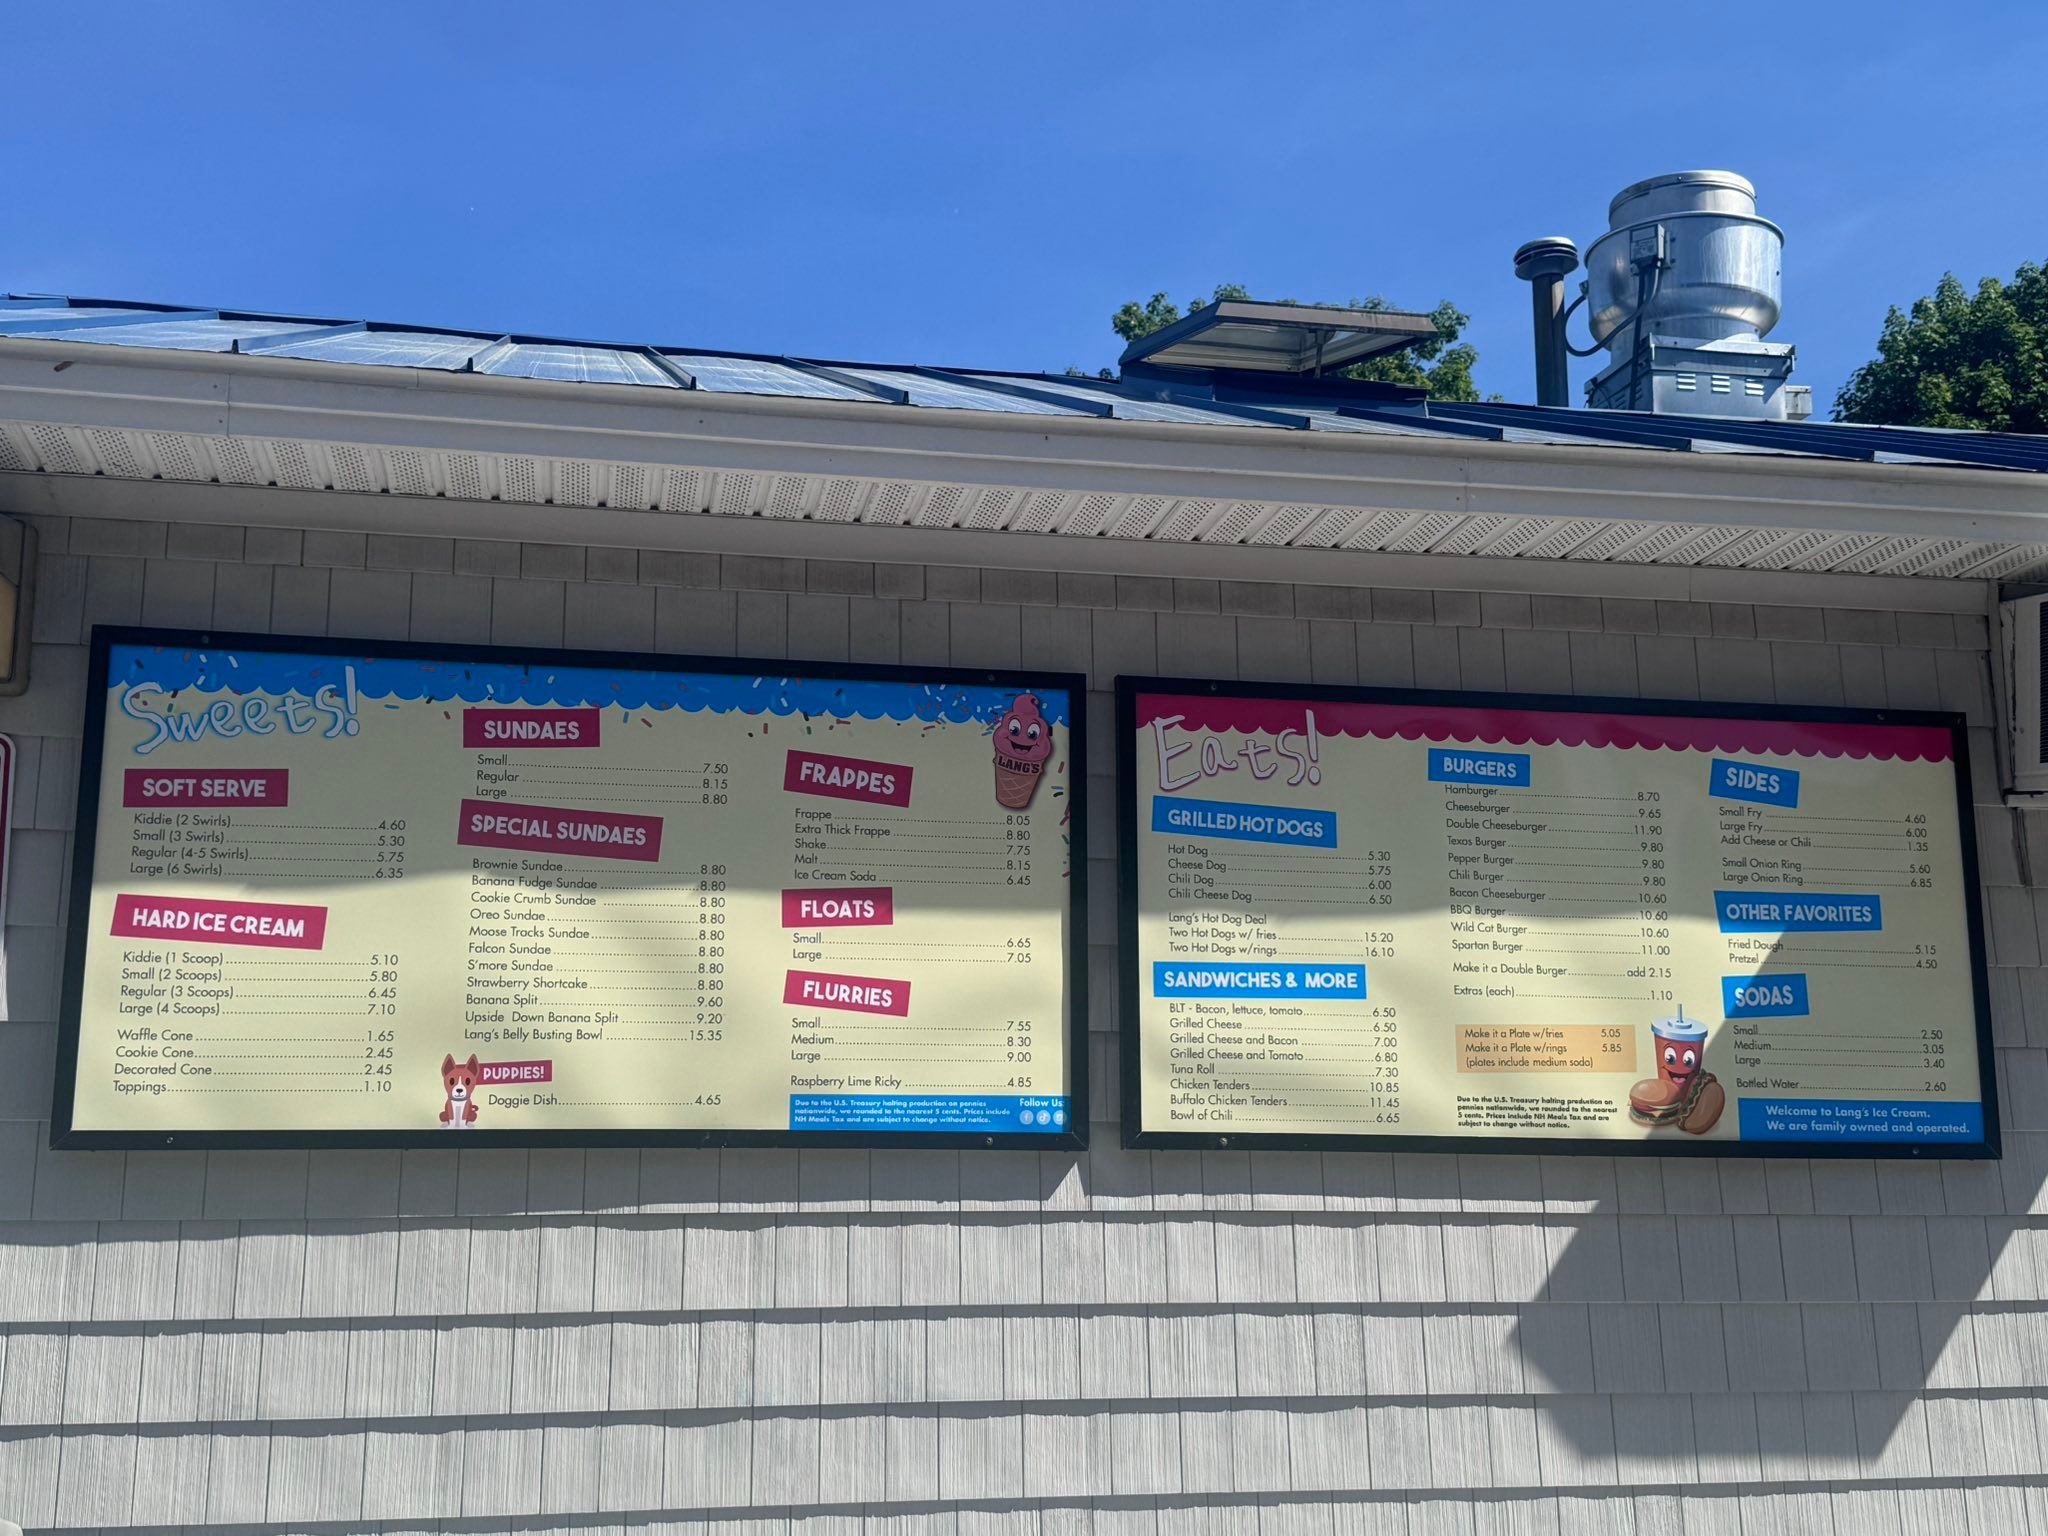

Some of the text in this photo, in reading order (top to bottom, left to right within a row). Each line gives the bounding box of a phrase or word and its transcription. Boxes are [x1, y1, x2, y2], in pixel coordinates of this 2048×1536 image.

[121, 664, 360, 755] Sweets!
[484, 720, 580, 740] SUNDAES
[1151, 708, 1322, 791] Eats!
[477, 754, 729, 775] Small 7.50
[997, 754, 1041, 774] LANG'S
[1443, 757, 1517, 778] BURGERS
[799, 761, 896, 795] FRAPPES
[1726, 767, 1780, 794] SIDES
[142, 778, 267, 798] SOFT SERVE
[1444, 783, 1660, 802] Hamburger 8.70
[133, 813, 407, 831] Kiddie (2 Swirls) 4.60
[795, 808, 1031, 826] Frappe 8.05
[1167, 809, 1323, 838] GRILLED HOT DOGS
[1719, 806, 1926, 824] Small Fry 4.60
[471, 814, 647, 846] SPECIAL SUNDAES
[795, 823, 1031, 841] Extra Thick Frappe 8.80
[1446, 818, 1663, 835] Double Cheeseburger 11.90
[472, 858, 726, 876] Brownie Sundae 8.80
[794, 869, 1031, 886] Ice Cream Soda 6.45
[1722, 872, 1932, 888] Large Onion Ring 6.85
[470, 891, 726, 908] Cookie Crumb Sundae 8.80
[1168, 888, 1392, 905] Chili Cheese Dog 6.50
[800, 899, 875, 919] FLOATS
[1726, 903, 1872, 922] OTHER FAVORITES
[132, 907, 305, 937] HARD ICE CREAM
[1450, 921, 1669, 938] Wild Cat Burger 10.60
[792, 932, 1031, 948] Small 6.65
[1168, 941, 1395, 957] Two Hot Dogs w/rings 16.10
[467, 959, 724, 974] S'more Sundae 8.80
[1729, 953, 1938, 969] Pretzel 4.50
[121, 968, 398, 983] Small (2 Scoops) 5.80
[466, 976, 724, 991] Strawberry Shortcake 8.80
[1164, 970, 1358, 988] SANDWICHES & MORE
[466, 993, 723, 1008] Banana Split 9.60
[803, 980, 893, 1008] FLURRIES
[1453, 984, 1673, 1000] Extras (each) 1.10
[1734, 984, 1794, 1007] SODAS
[118, 1002, 396, 1016] Large (4 Scoops) 7.10
[1169, 1003, 1186, 1014] BLT
[1195, 1003, 1229, 1015] Bacon,
[1232, 1003, 1267, 1016] lettuce,
[1268, 1004, 1303, 1016] tomato
[1372, 1007, 1396, 1017] 6.50
[464, 1028, 723, 1042] Lang's Belly Busting Bowl 15.35
[791, 1033, 1032, 1048] Medium 8.30
[114, 1063, 392, 1076] Decorated Cone 2.45
[1466, 1056, 1594, 1068] (plates include medium soda)
[1734, 1055, 1945, 1068] Large 3.40
[483, 1065, 545, 1080] PUPPIES!
[112, 1080, 392, 1095] Toppings 1.10
[790, 1075, 1032, 1089] Raspberry Lime Ricky 4.85
[1736, 1078, 1947, 1092] Bottled Water 2.60
[488, 1093, 722, 1108] Doggie Dish 4.65
[1019, 1098, 1049, 1107] Follow
[1170, 1094, 1400, 1108] Buffalo Chicken Tenders 11.45
[1170, 1109, 1400, 1123] Bowl of Chili 6.65
[1766, 1105, 1931, 1120] Welcome to Lang's Ice Cream.
[1457, 1120, 1482, 1129] subject
[1492, 1120, 1517, 1130] change
[1519, 1120, 1546, 1128] without
[1767, 1120, 1970, 1135] We are family owned and operated.
